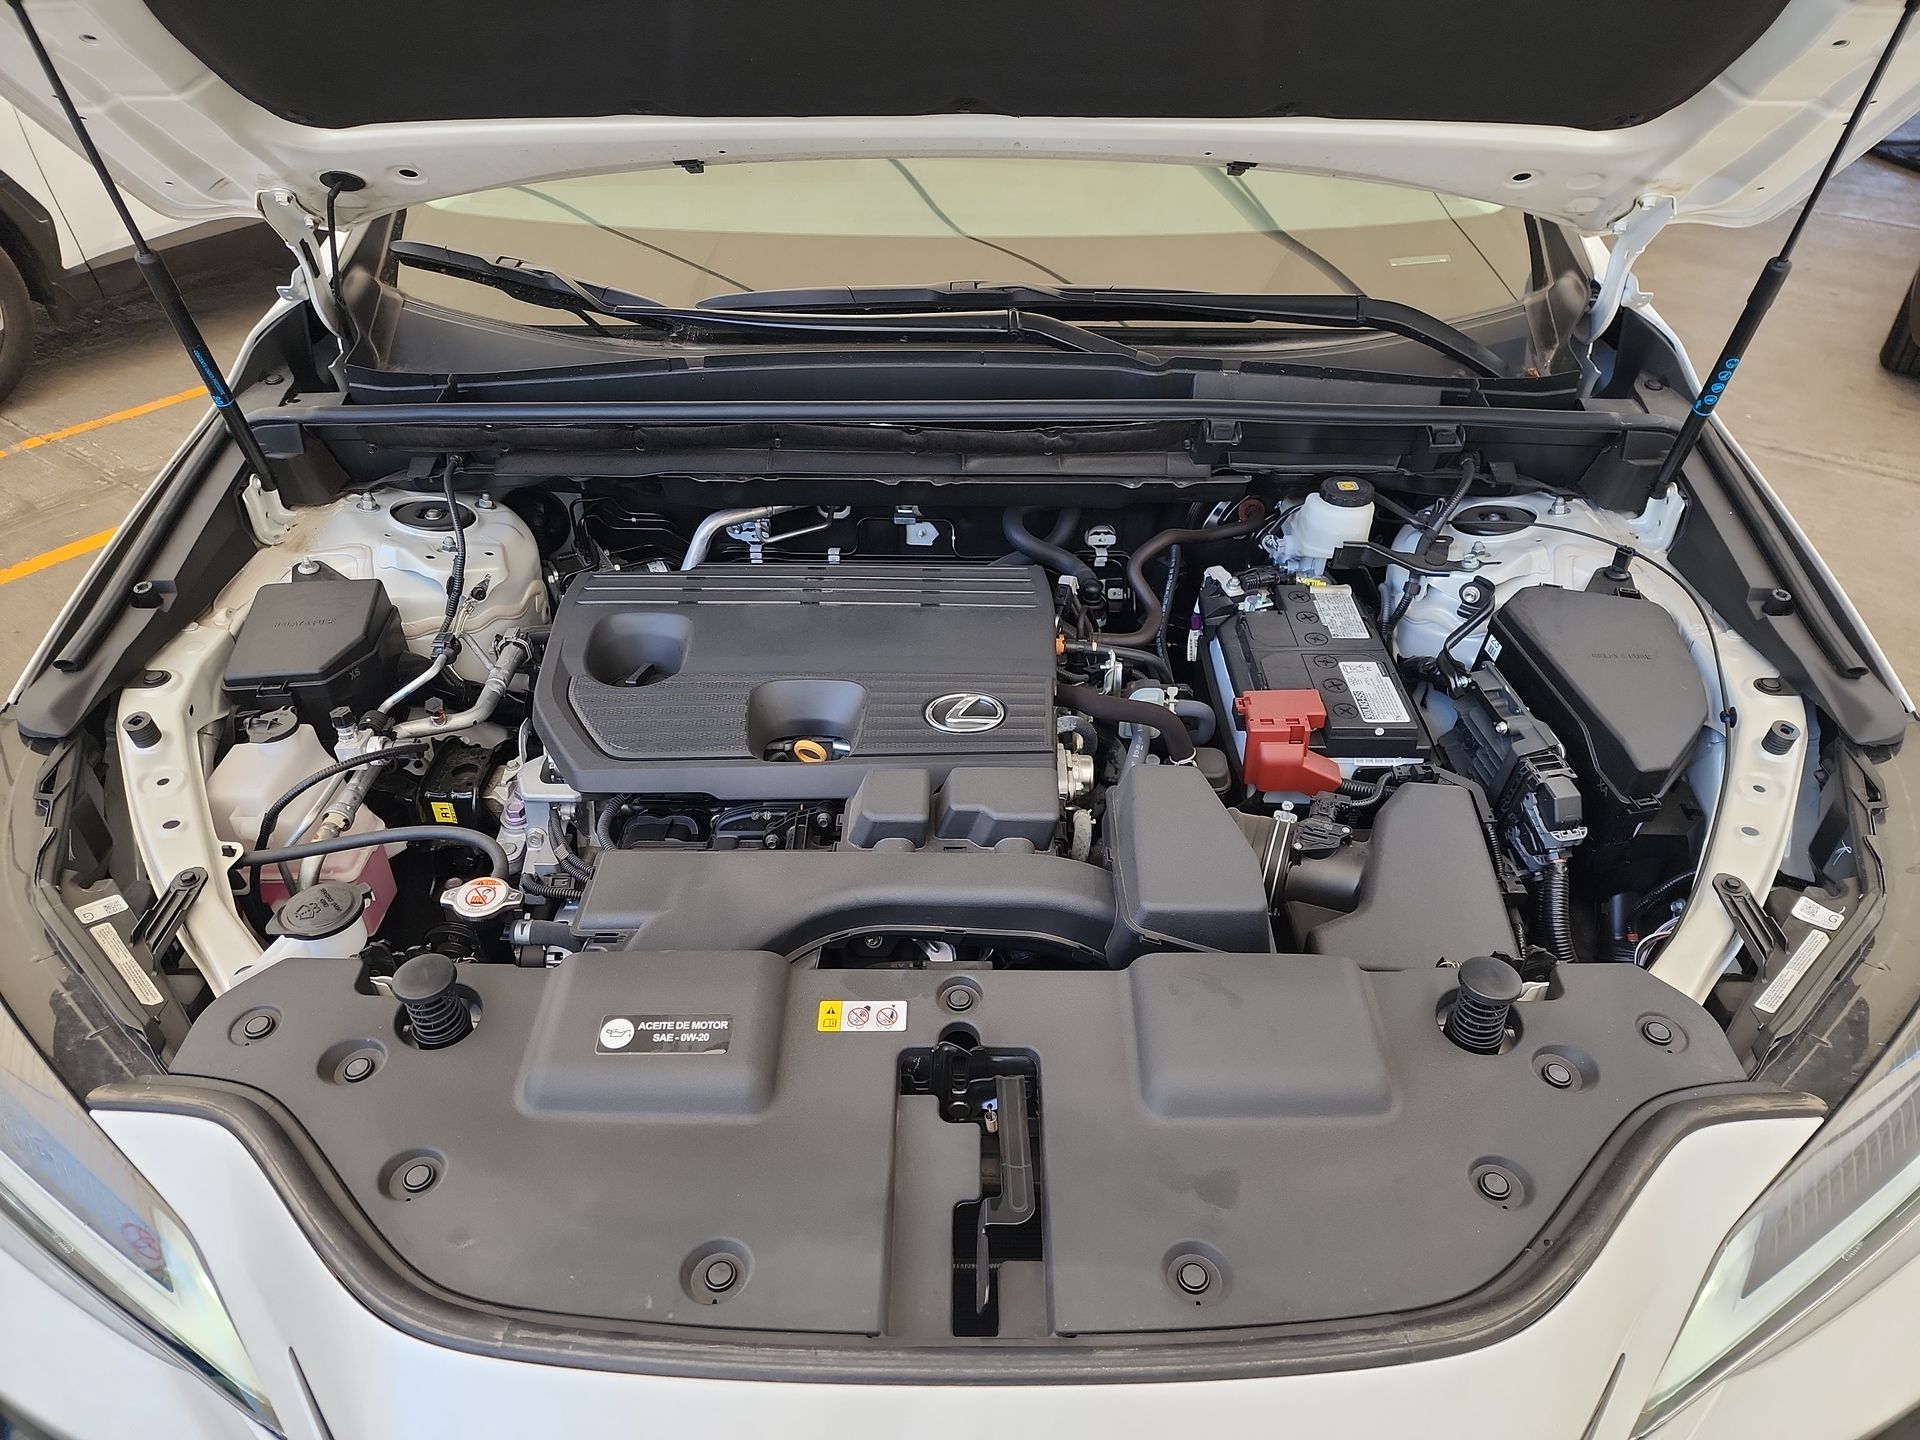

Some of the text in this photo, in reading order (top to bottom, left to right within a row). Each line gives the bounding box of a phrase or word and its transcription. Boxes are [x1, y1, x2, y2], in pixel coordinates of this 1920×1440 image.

[439, 807, 451, 818] R1
[82, 912, 94, 921] G
[1828, 914, 1840, 924] G
[638, 1021, 728, 1031] ACEITE DE MOTOR
[652, 1033, 673, 1042] SAE
[681, 1033, 710, 1042] 0W-20
